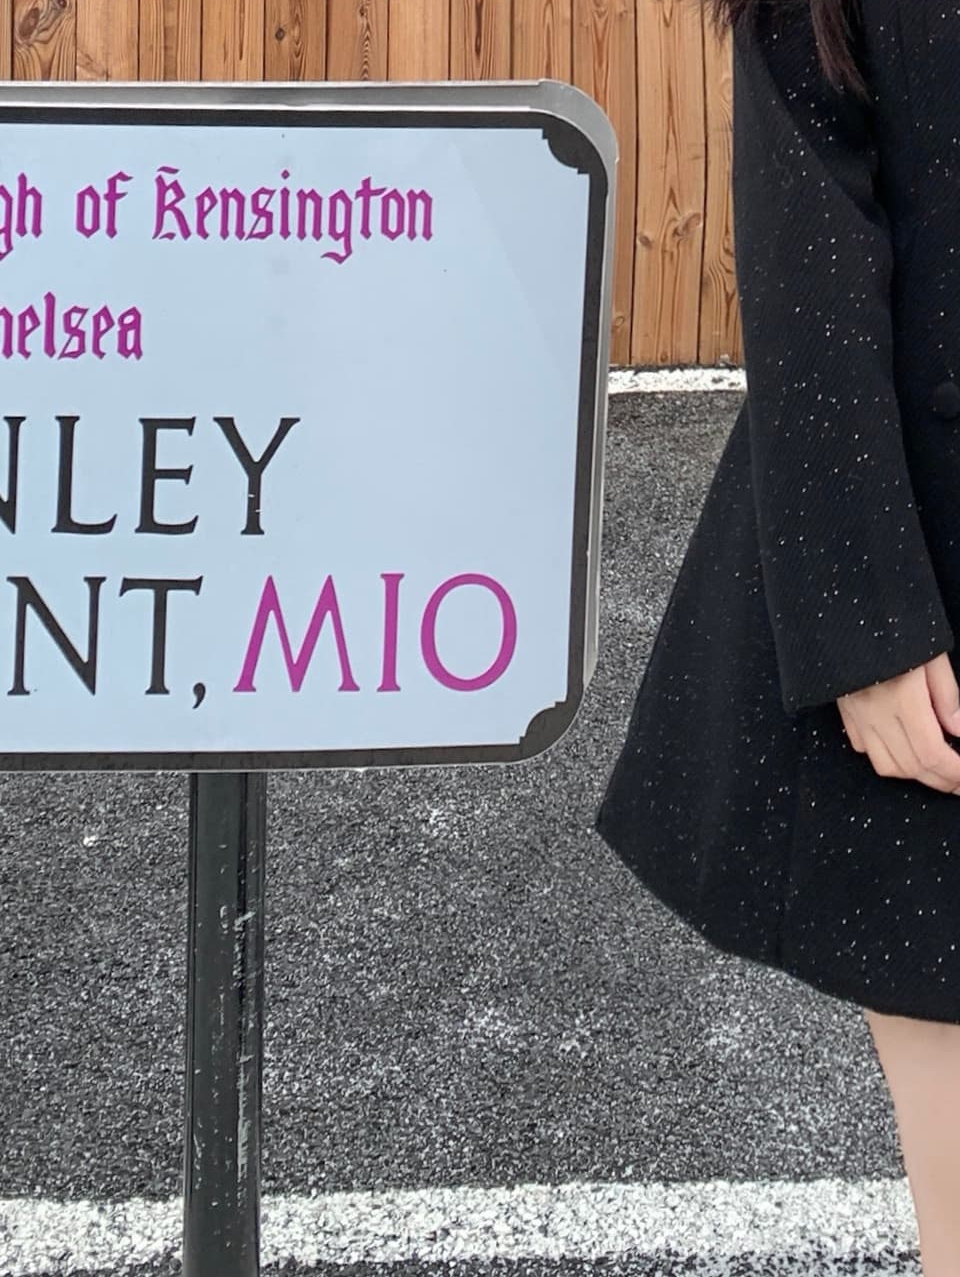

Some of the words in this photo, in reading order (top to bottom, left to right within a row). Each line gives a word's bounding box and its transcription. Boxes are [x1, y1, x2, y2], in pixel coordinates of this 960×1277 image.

[75, 171, 134, 240] of
[152, 166, 433, 265] Kensington
[0, 415, 301, 536] LEY
[6, 575, 206, 710] NT,
[233, 573, 518, 693] MIO
